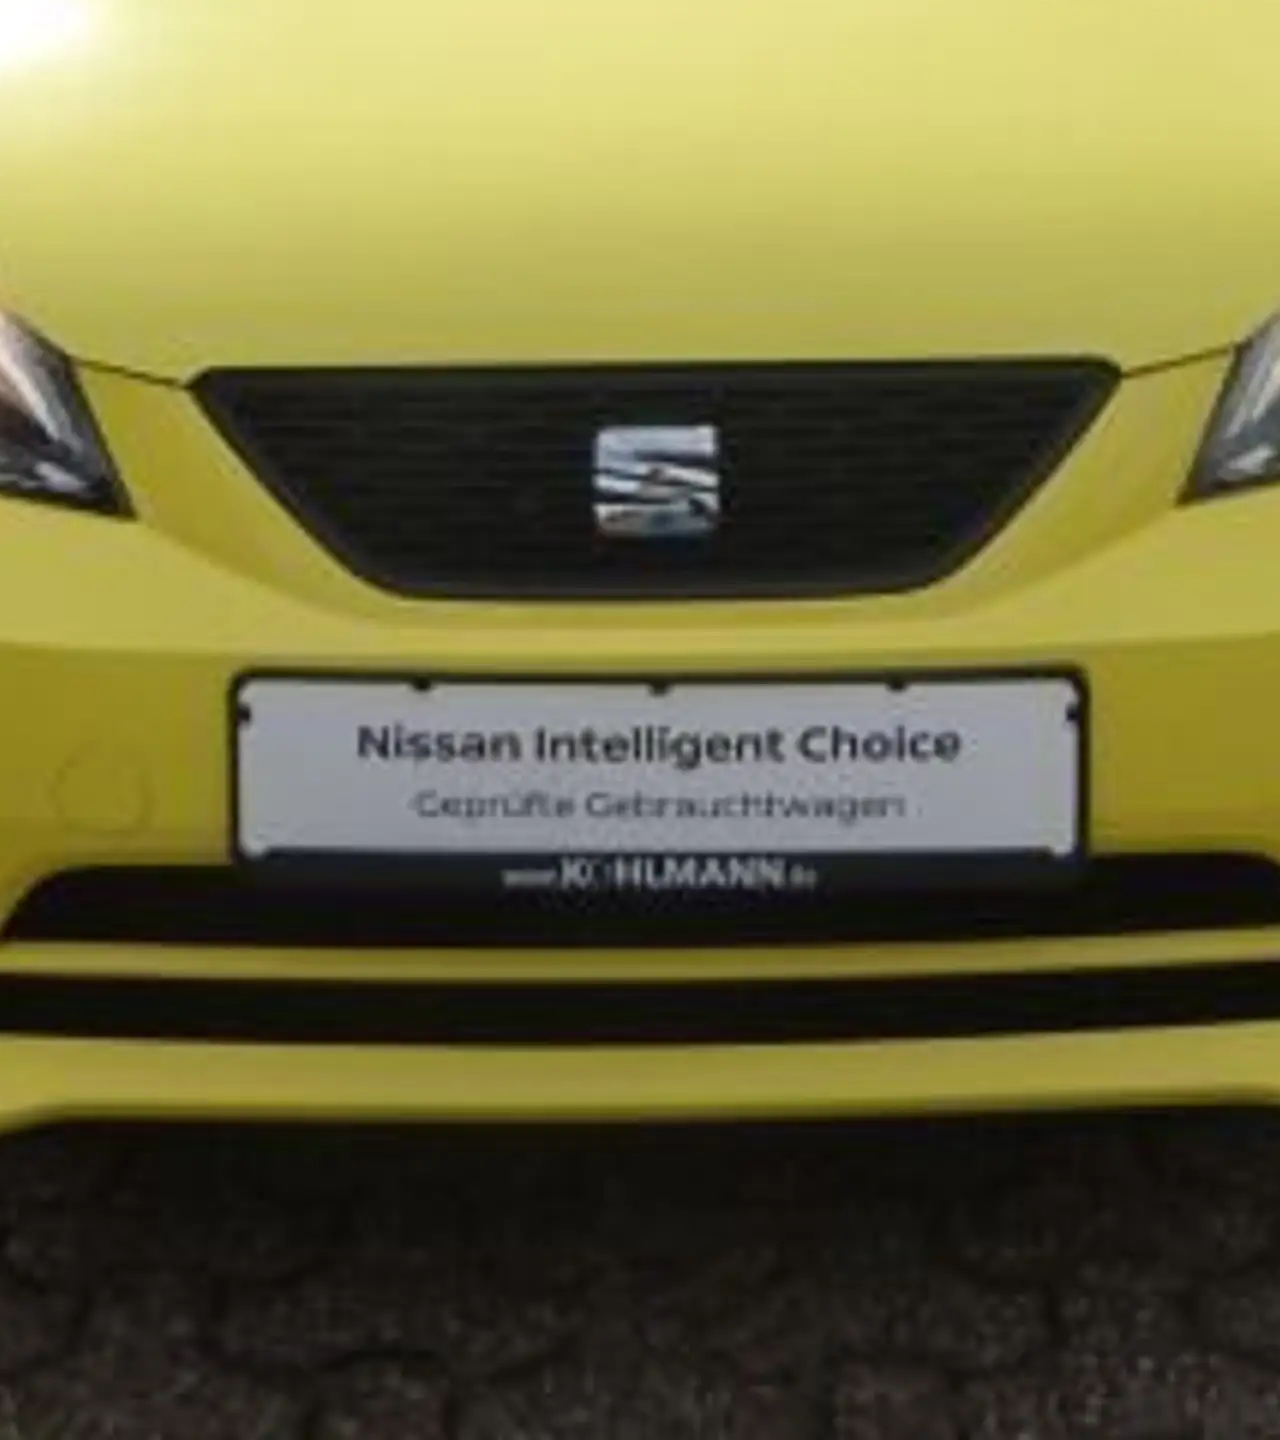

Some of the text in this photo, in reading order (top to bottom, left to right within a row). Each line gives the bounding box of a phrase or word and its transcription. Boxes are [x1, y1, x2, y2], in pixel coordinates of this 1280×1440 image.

[356, 723, 963, 772] Nissan Intelligent Choice
[584, 789, 907, 826] Gebrauchtwagen
